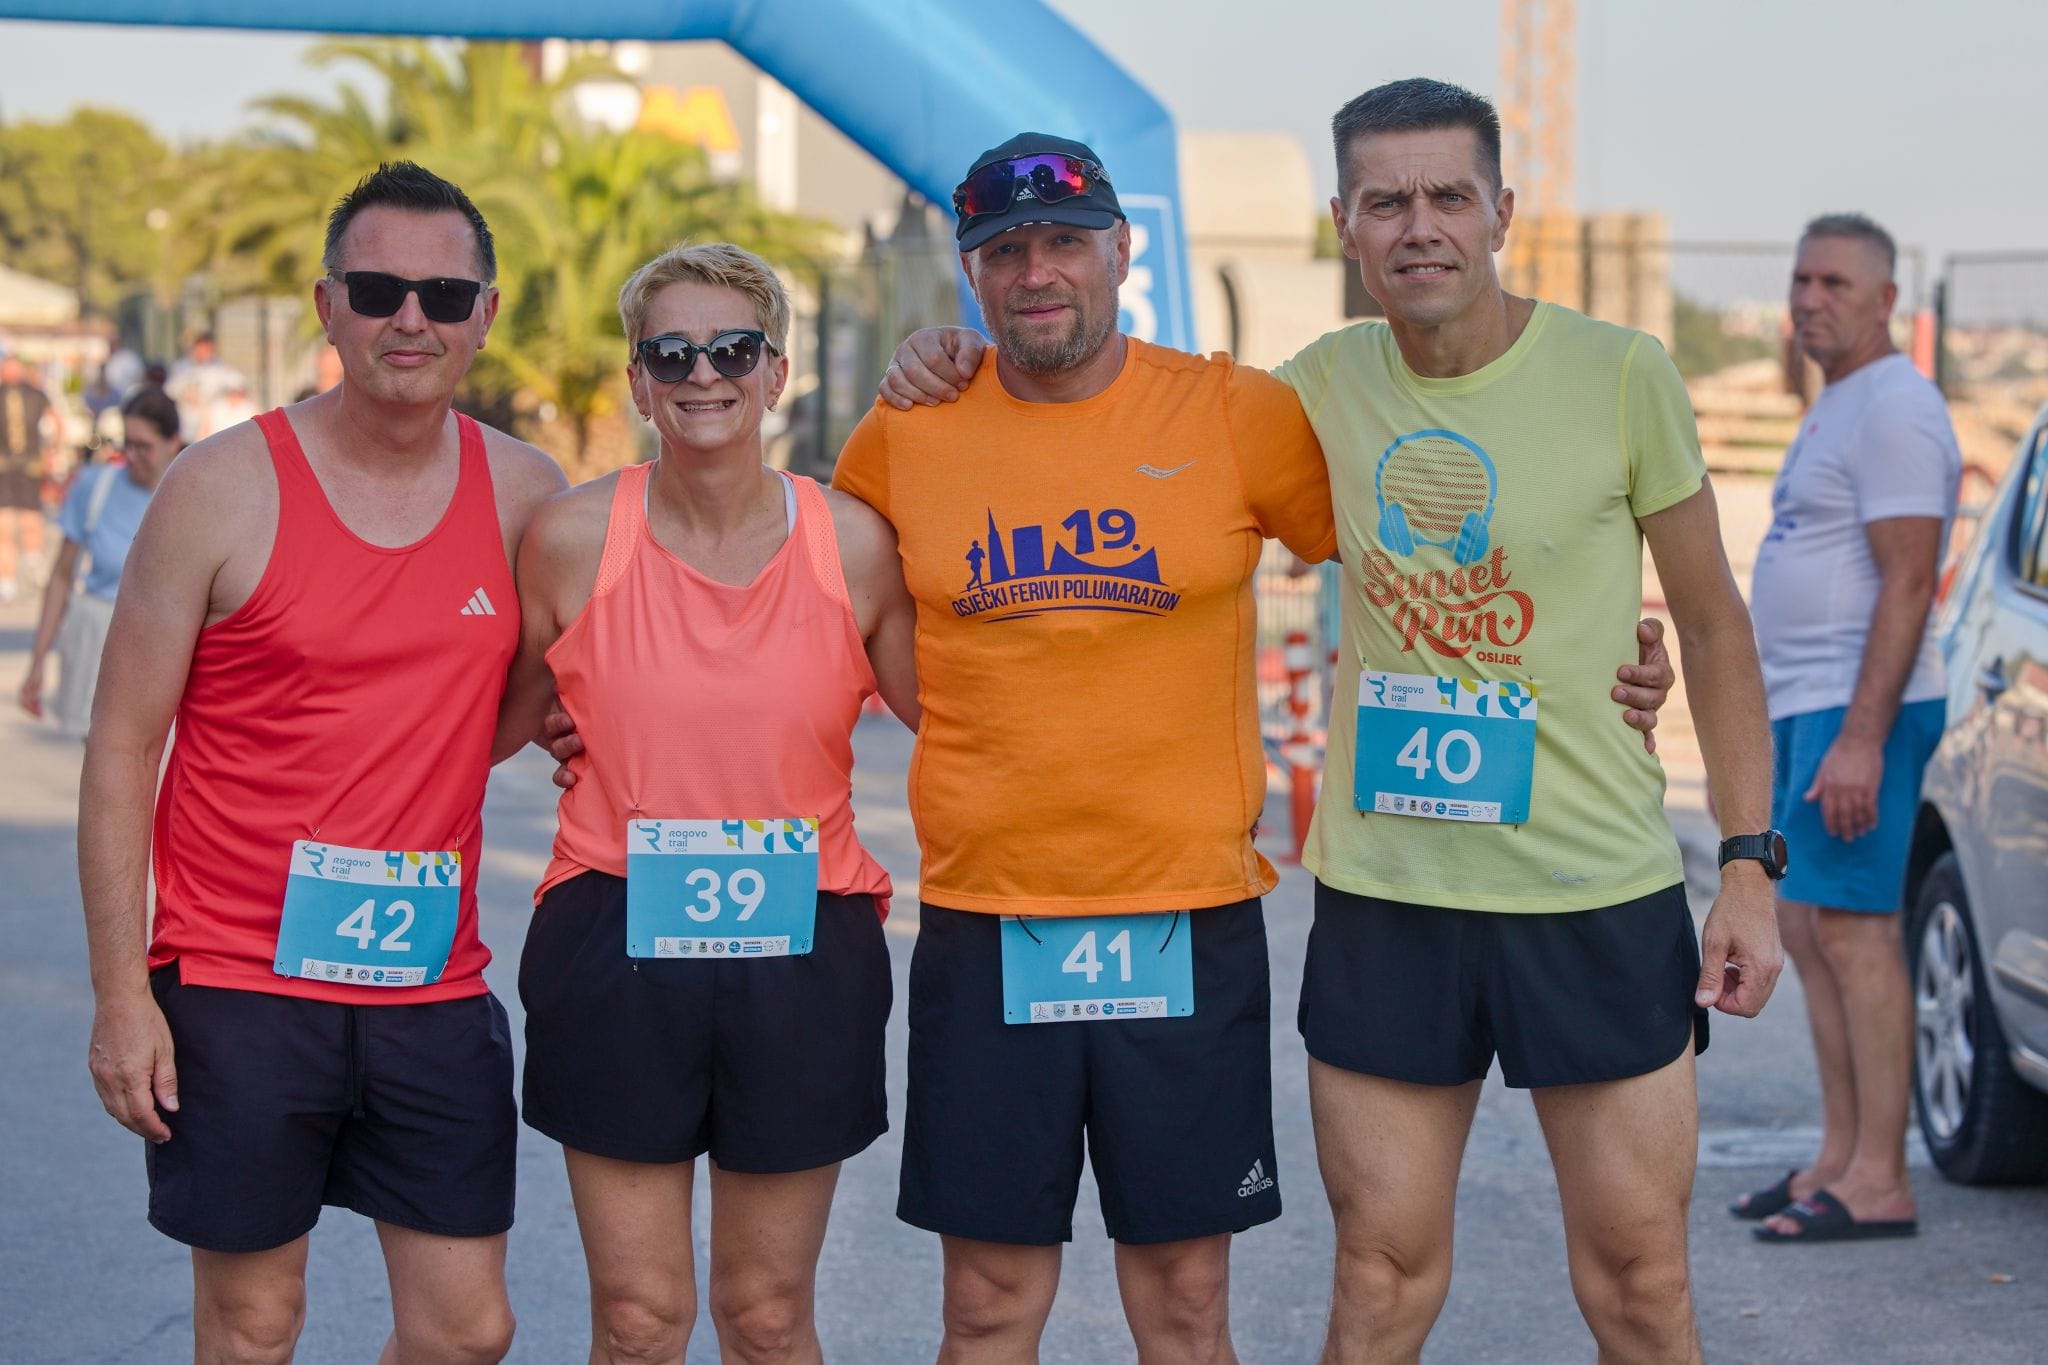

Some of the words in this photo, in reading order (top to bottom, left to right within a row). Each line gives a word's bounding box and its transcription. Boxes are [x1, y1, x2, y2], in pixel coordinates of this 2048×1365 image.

[1061, 508, 1141, 555] 19.
[1361, 545, 1512, 608] Sunset
[1010, 580, 1059, 604] FERIVI
[1063, 579, 1181, 611] POLUMARATON
[1392, 590, 1534, 658] Run
[1476, 651, 1523, 666] OSIJEK
[1391, 685, 1424, 694] Rogovo
[1391, 694, 1407, 702] trail
[1396, 727, 1482, 784] 40
[668, 830, 708, 840] Rogovo
[668, 839, 688, 847] trail
[331, 866, 351, 875] trail
[333, 857, 371, 868] Rogovo
[685, 868, 766, 922] 39
[336, 899, 415, 951] 42
[1062, 929, 1132, 983] 41
[1237, 1177, 1274, 1197] adidas
